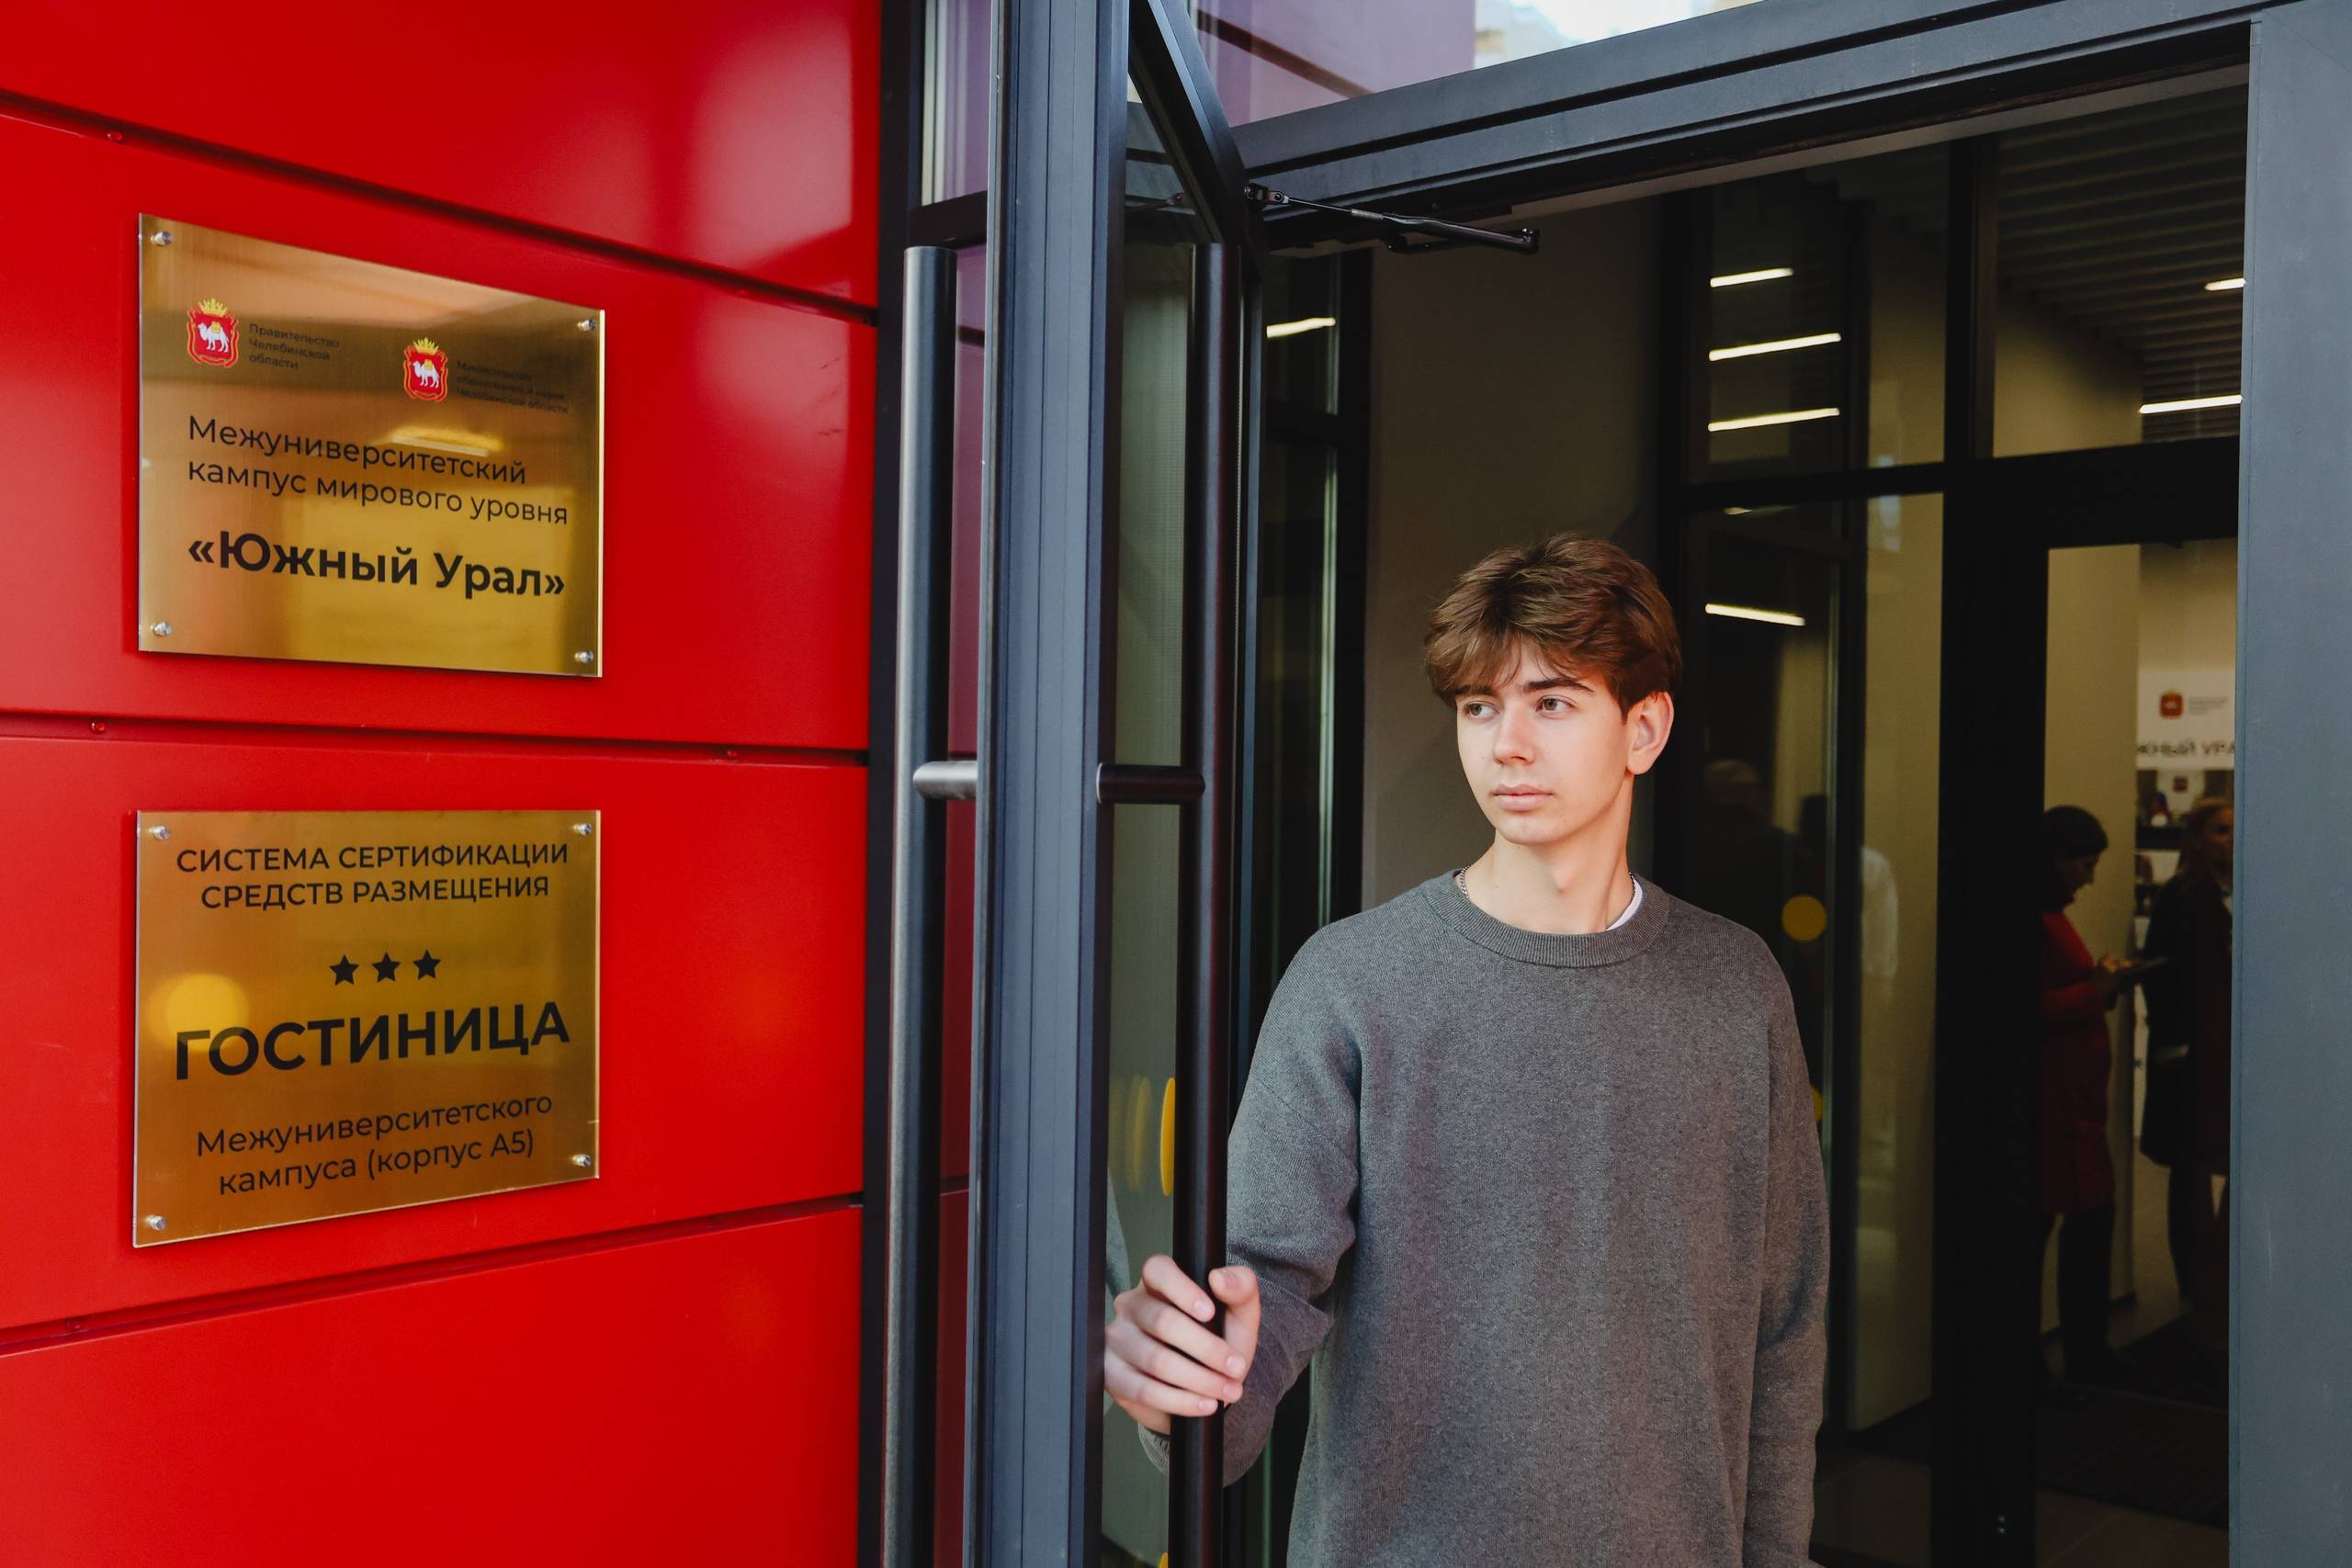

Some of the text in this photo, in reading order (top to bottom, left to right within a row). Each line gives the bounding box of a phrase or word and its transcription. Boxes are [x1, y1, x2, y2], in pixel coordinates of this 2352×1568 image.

[250, 323, 339, 347] Правительство
[250, 338, 330, 360] Челябинской
[250, 353, 298, 369] области
[189, 416, 526, 484] Межуниверситетский
[189, 461, 568, 525] кампус мирового уровня
[189, 531, 566, 599] «Южный Урал»
[176, 843, 568, 872] СИСТЕМА СЕРТИФИКАЦИИ
[201, 876, 549, 910] СРЕДСТВ РАЗМЕЩЕНИЯ
[176, 1000, 571, 1080] ГОСТИНИЦА
[197, 1095, 552, 1156] Межуниверситетского
[220, 1129, 534, 1195] кампуса (корпус А5)
